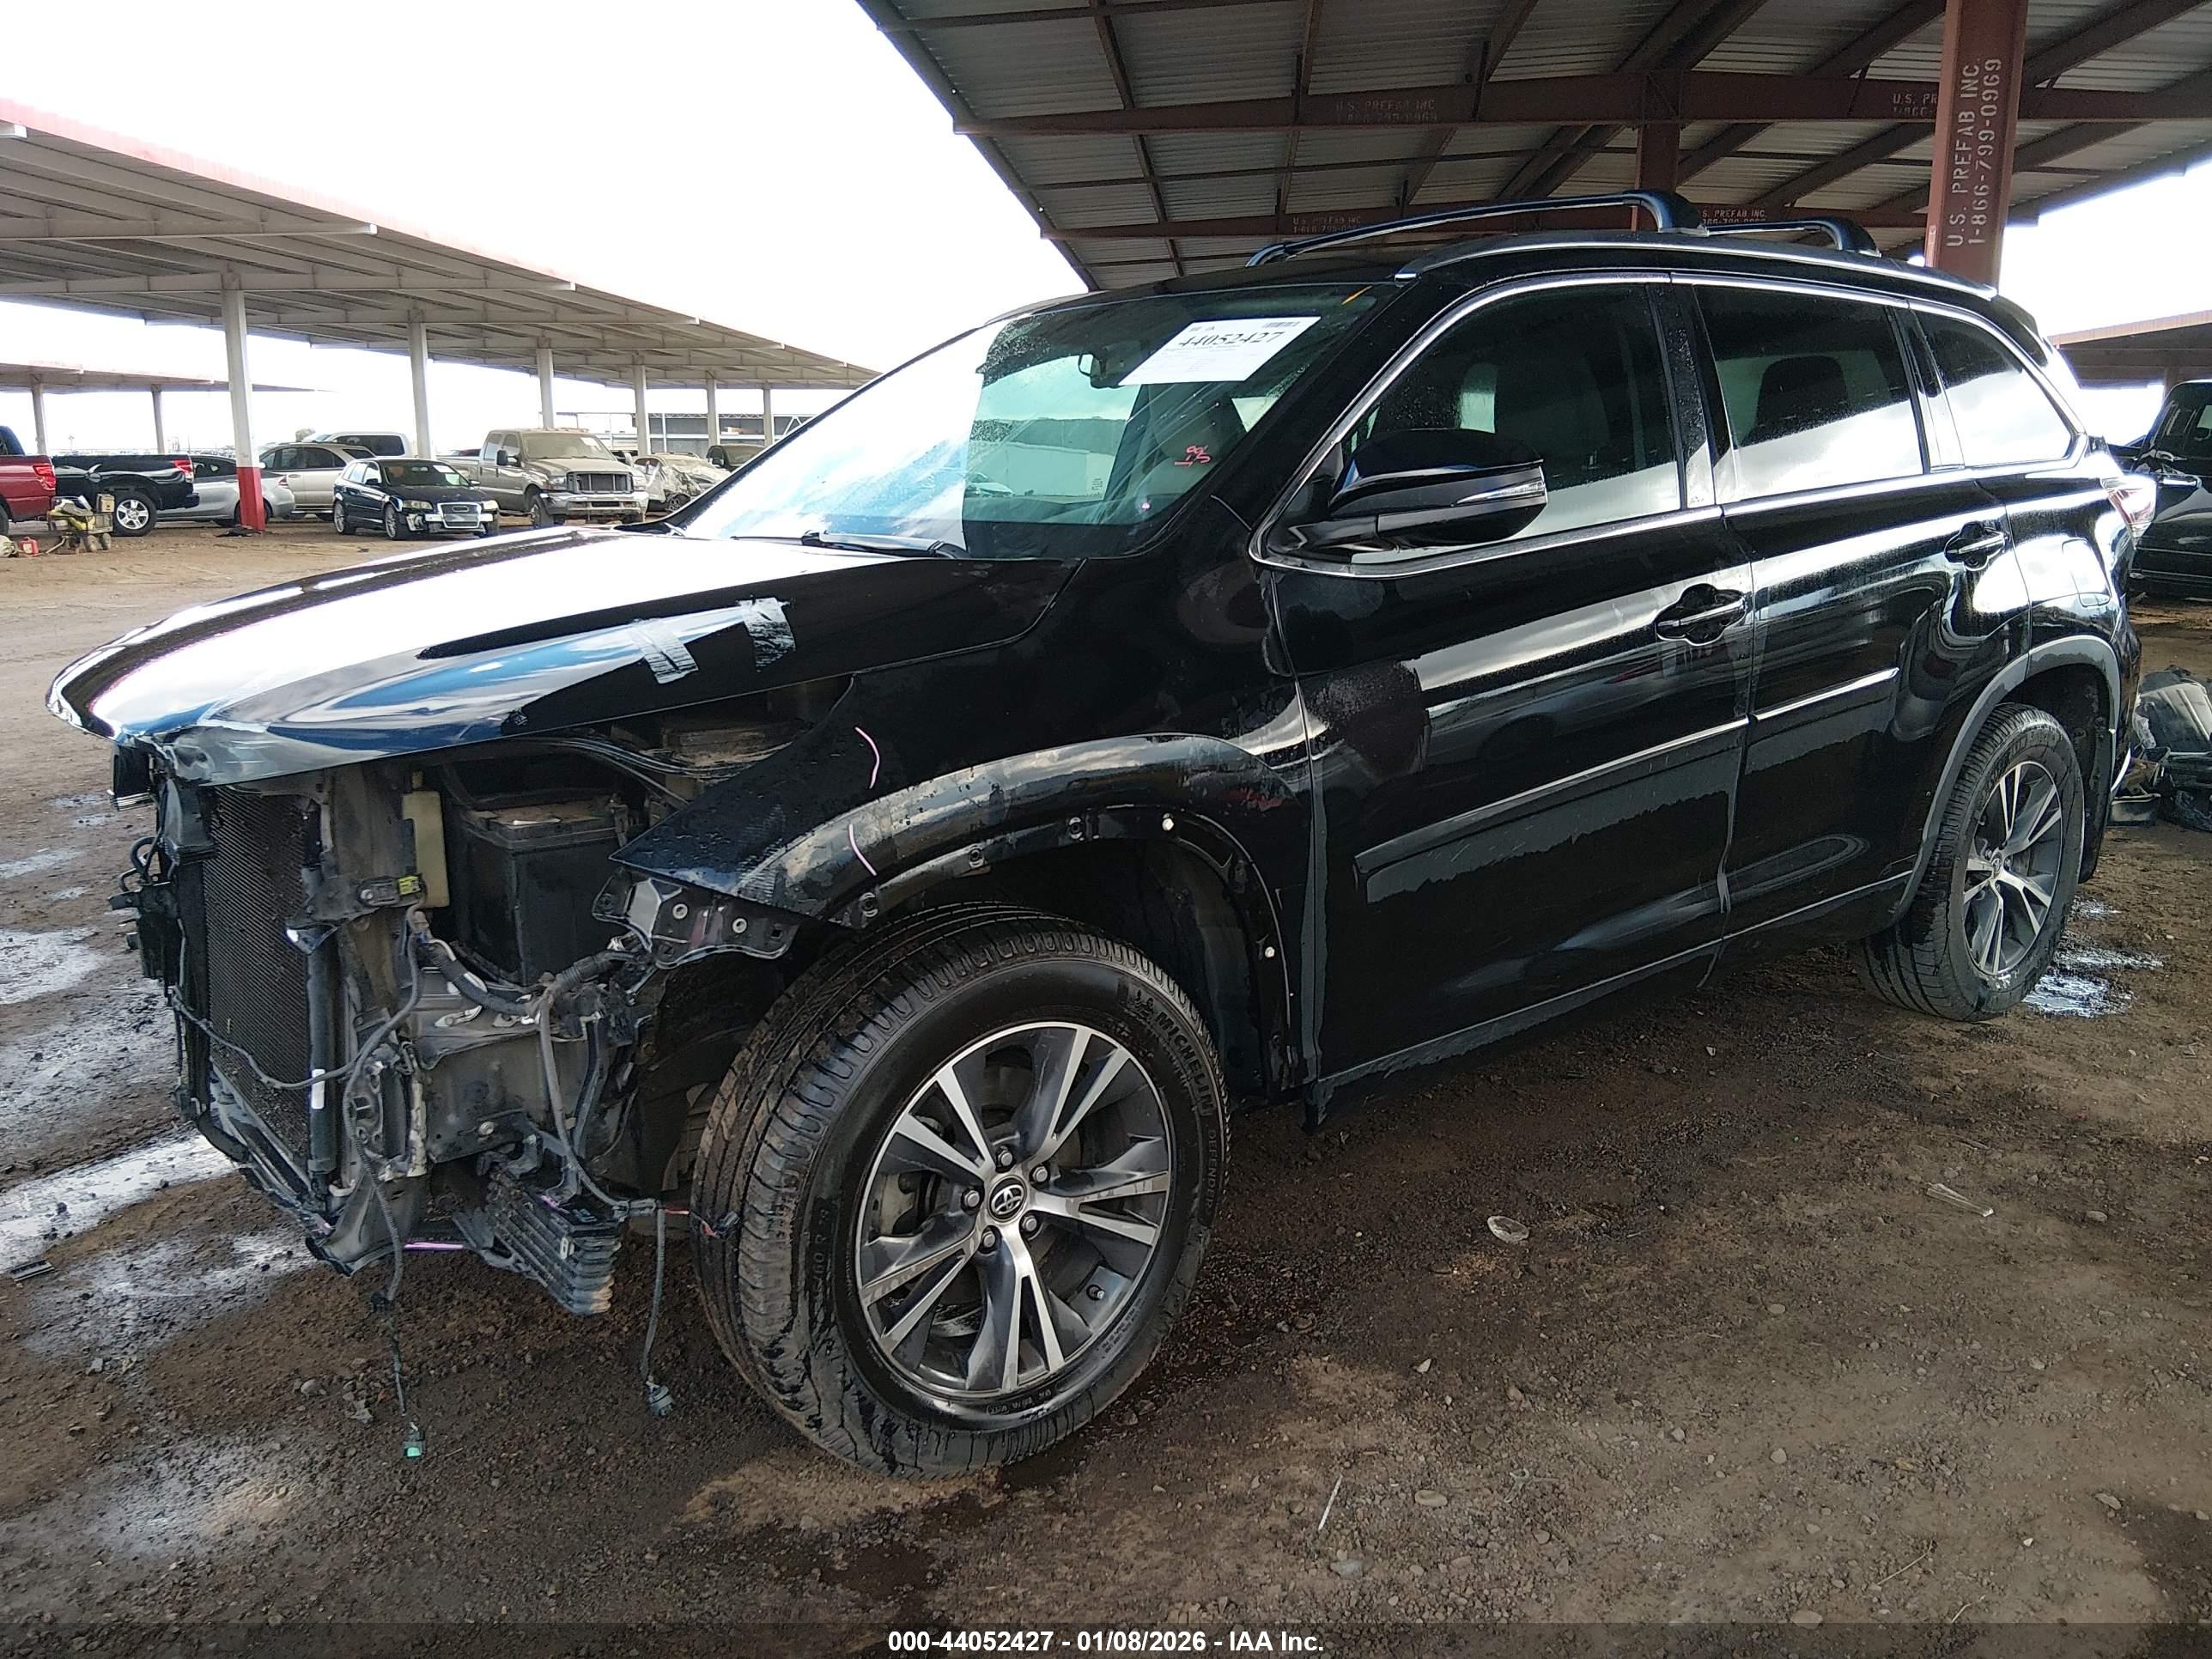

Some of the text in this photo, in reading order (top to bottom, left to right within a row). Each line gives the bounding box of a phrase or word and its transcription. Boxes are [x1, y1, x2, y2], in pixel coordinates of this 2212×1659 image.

[1951, 110, 1976, 194] PREFAB
[1967, 58, 2002, 246] 1-866-799-0969
[1714, 209, 1748, 218] PREFAB
[1946, 206, 1967, 247] U.S.
[1178, 331, 1285, 347] 44052427
[1156, 1012, 1216, 1116] MICHELIN
[1204, 1128, 1218, 1211] DEFENDER
